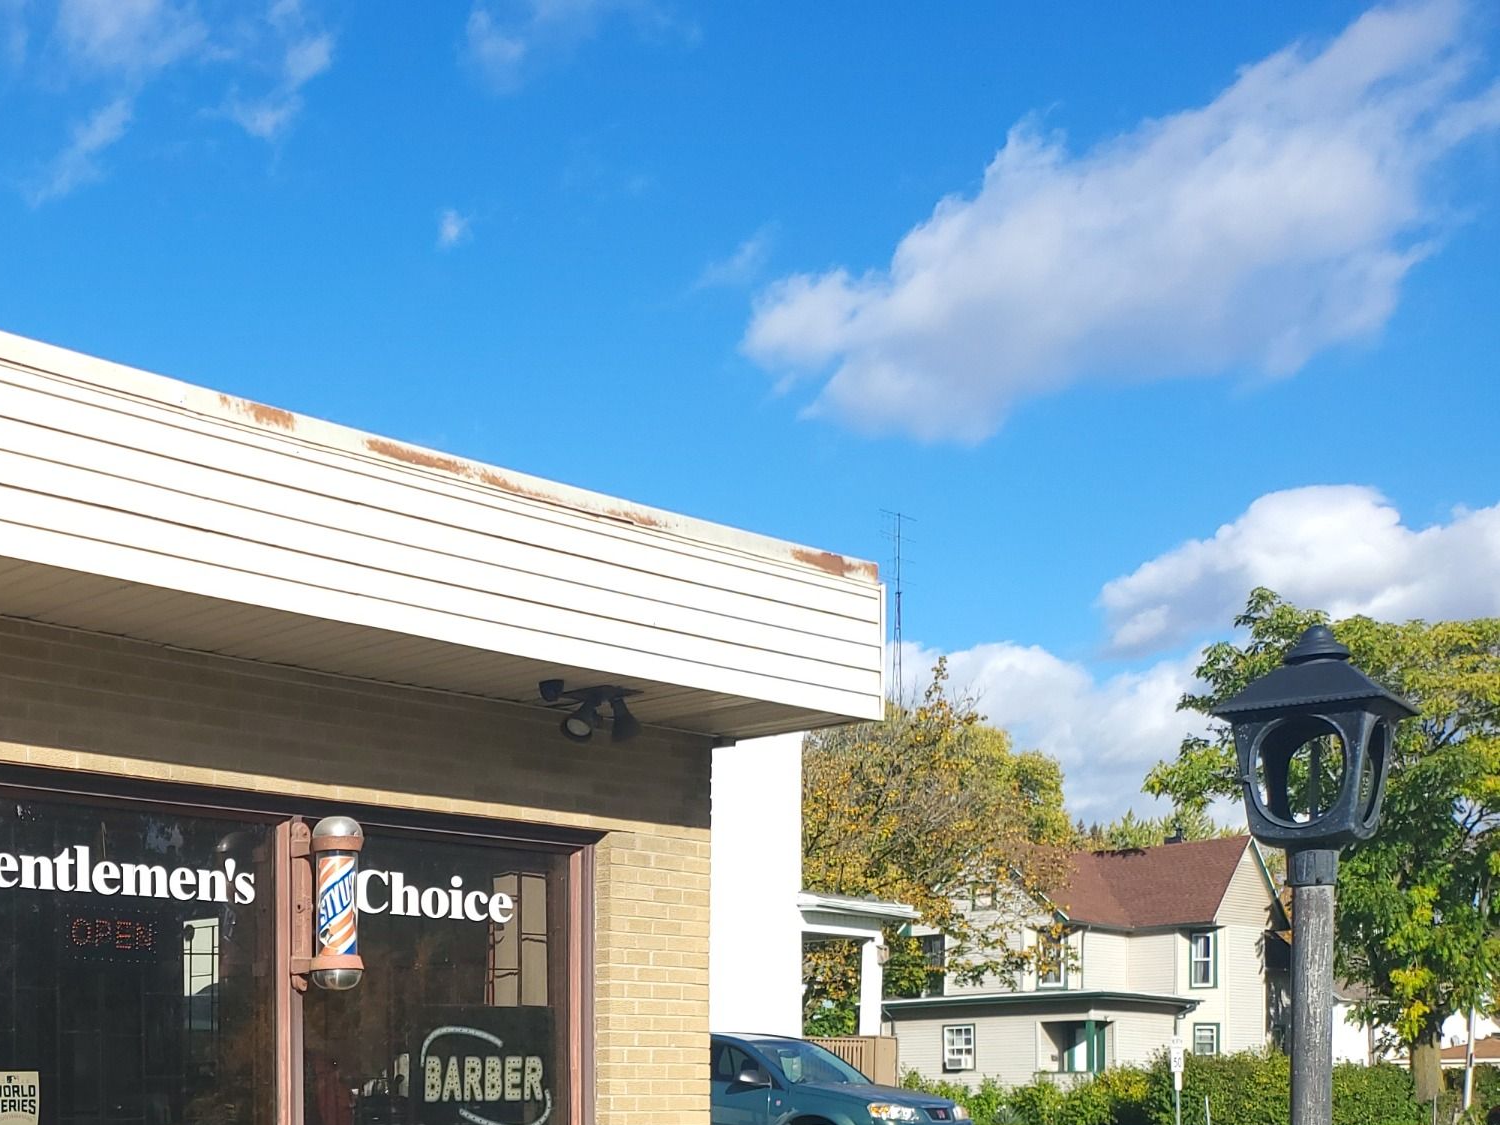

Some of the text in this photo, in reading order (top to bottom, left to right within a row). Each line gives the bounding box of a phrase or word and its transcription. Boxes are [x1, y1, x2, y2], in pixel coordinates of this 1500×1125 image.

[357, 869, 514, 923] Choice
[71, 918, 153, 950] OPEN
[424, 1055, 544, 1102] BARBER
